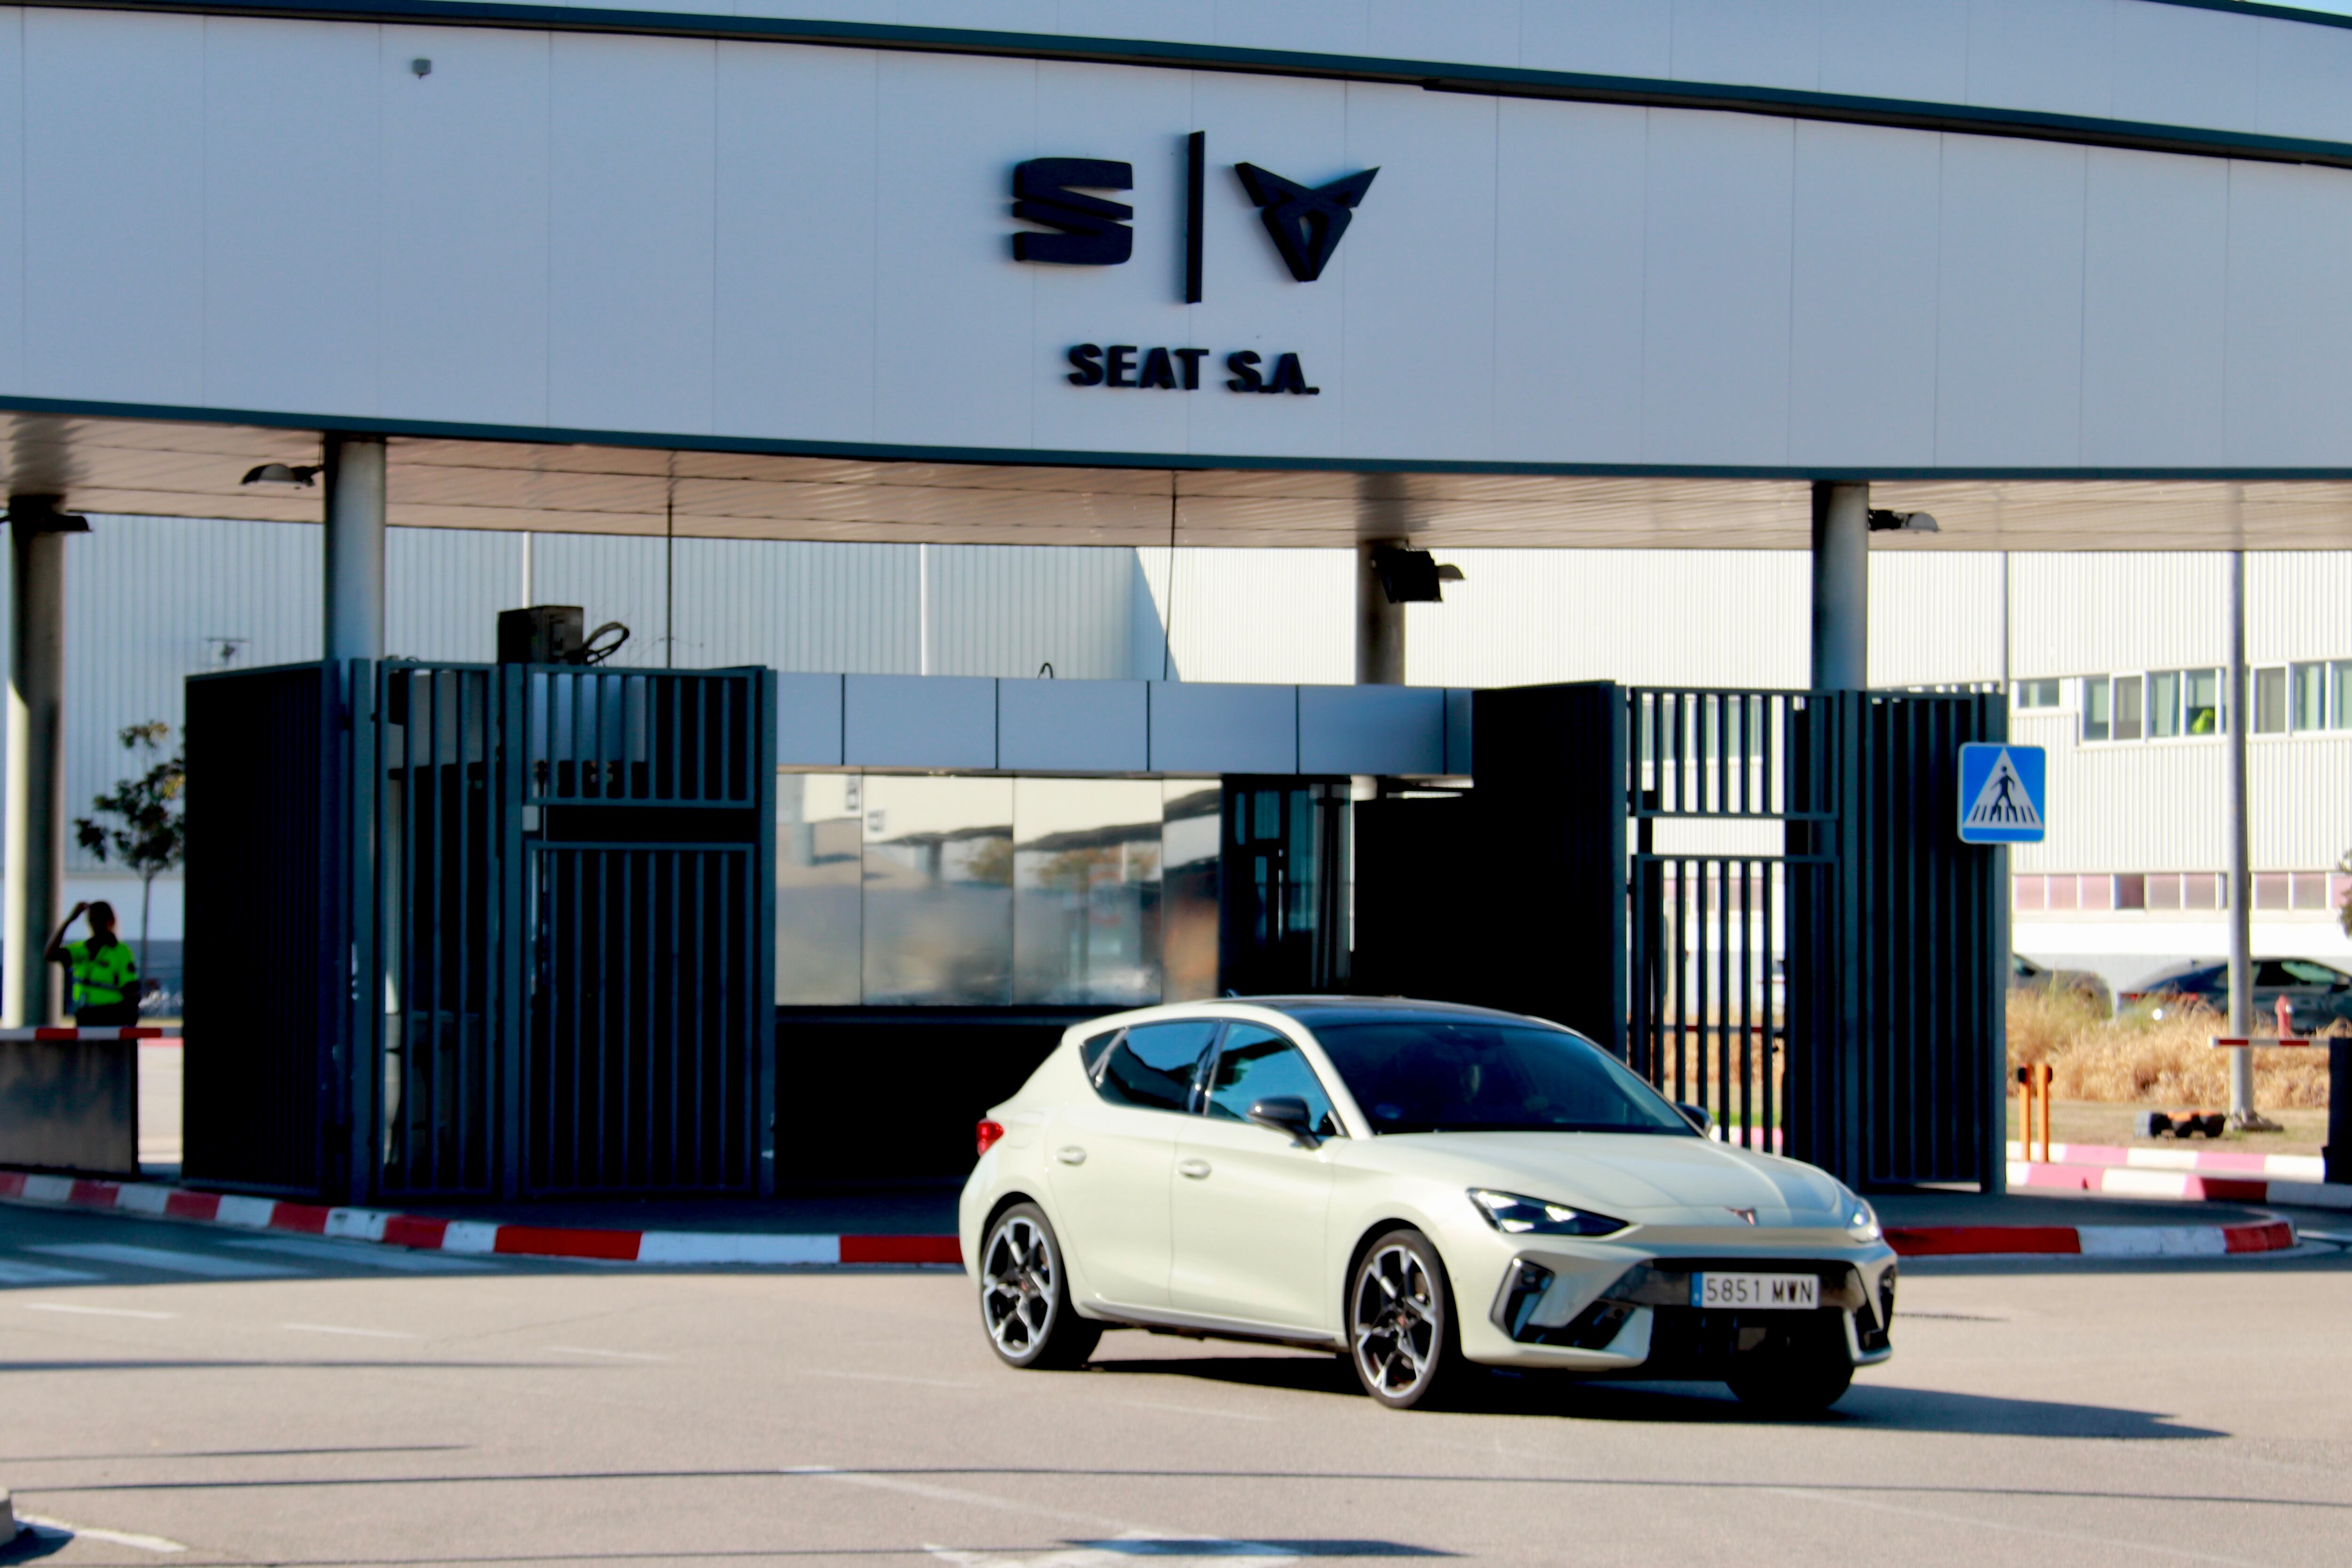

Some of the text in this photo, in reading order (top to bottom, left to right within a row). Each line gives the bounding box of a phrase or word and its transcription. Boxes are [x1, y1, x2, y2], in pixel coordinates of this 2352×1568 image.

[1068, 344, 1320, 394] SEAT S.A.
[1706, 1278, 1812, 1304] 5851 MWN
